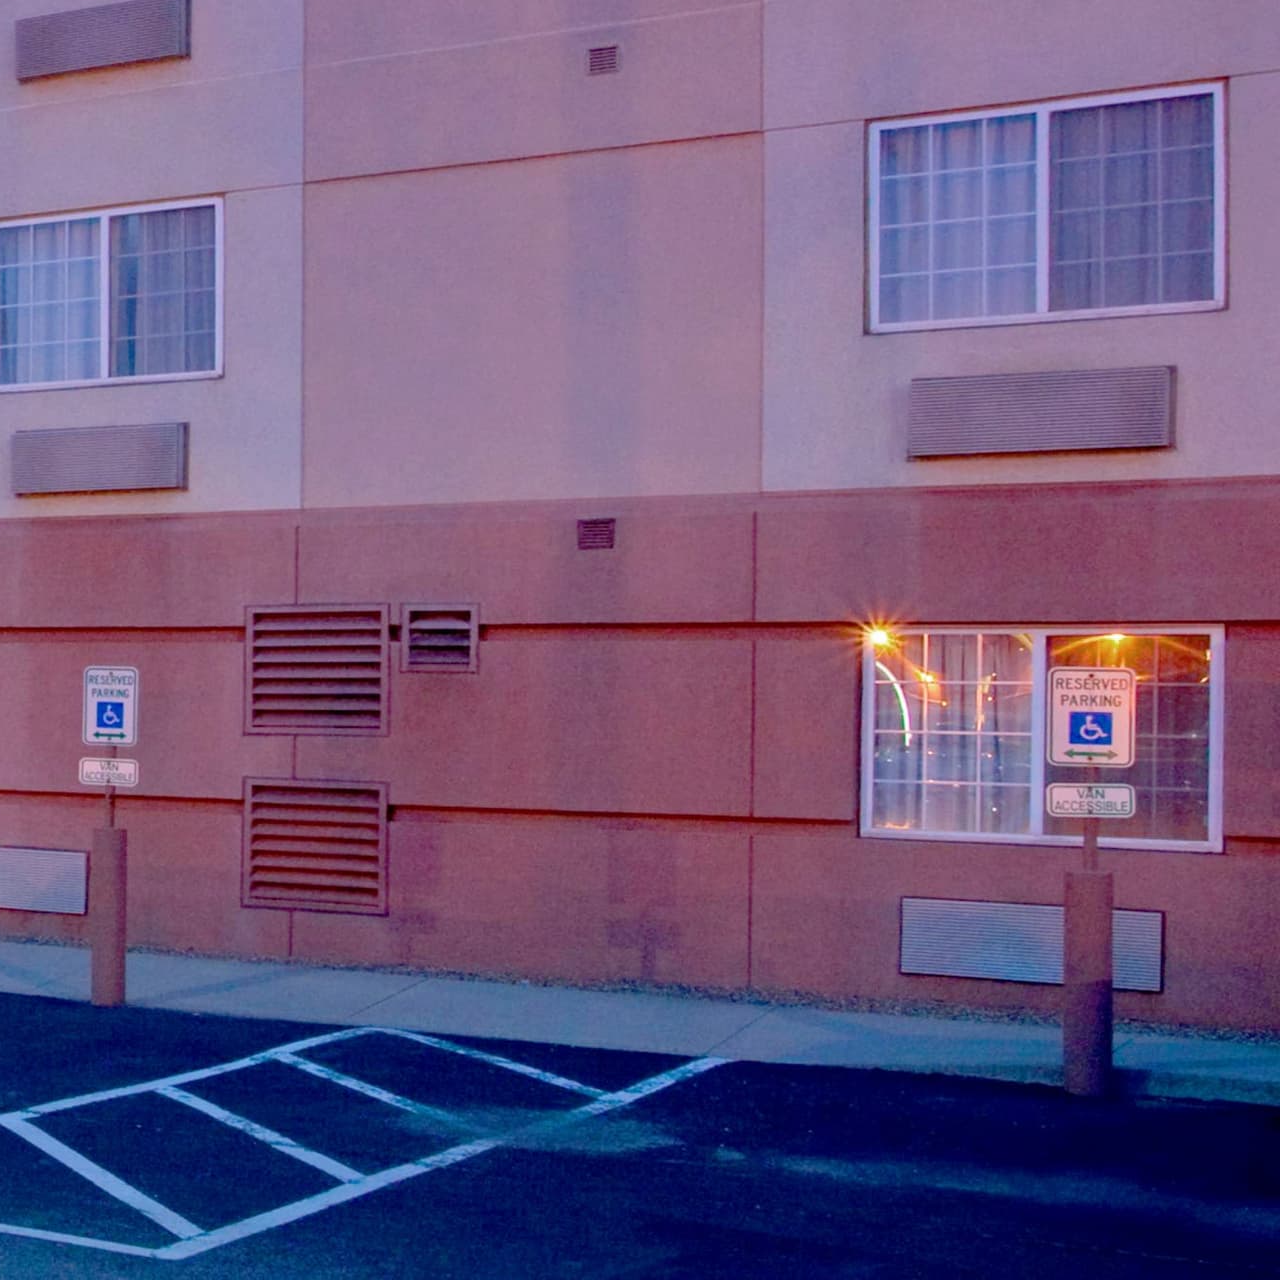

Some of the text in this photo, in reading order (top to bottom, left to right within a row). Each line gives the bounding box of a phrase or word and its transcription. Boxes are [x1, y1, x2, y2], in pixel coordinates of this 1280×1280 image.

[89, 674, 134, 686] RESERVED
[1055, 677, 1128, 691] RESERVED
[91, 687, 130, 699] PARKING
[1060, 694, 1122, 707] PARKING
[100, 761, 119, 771] VAN
[1077, 789, 1105, 799] VAN
[1054, 800, 1129, 813] ACCESSIBLE
